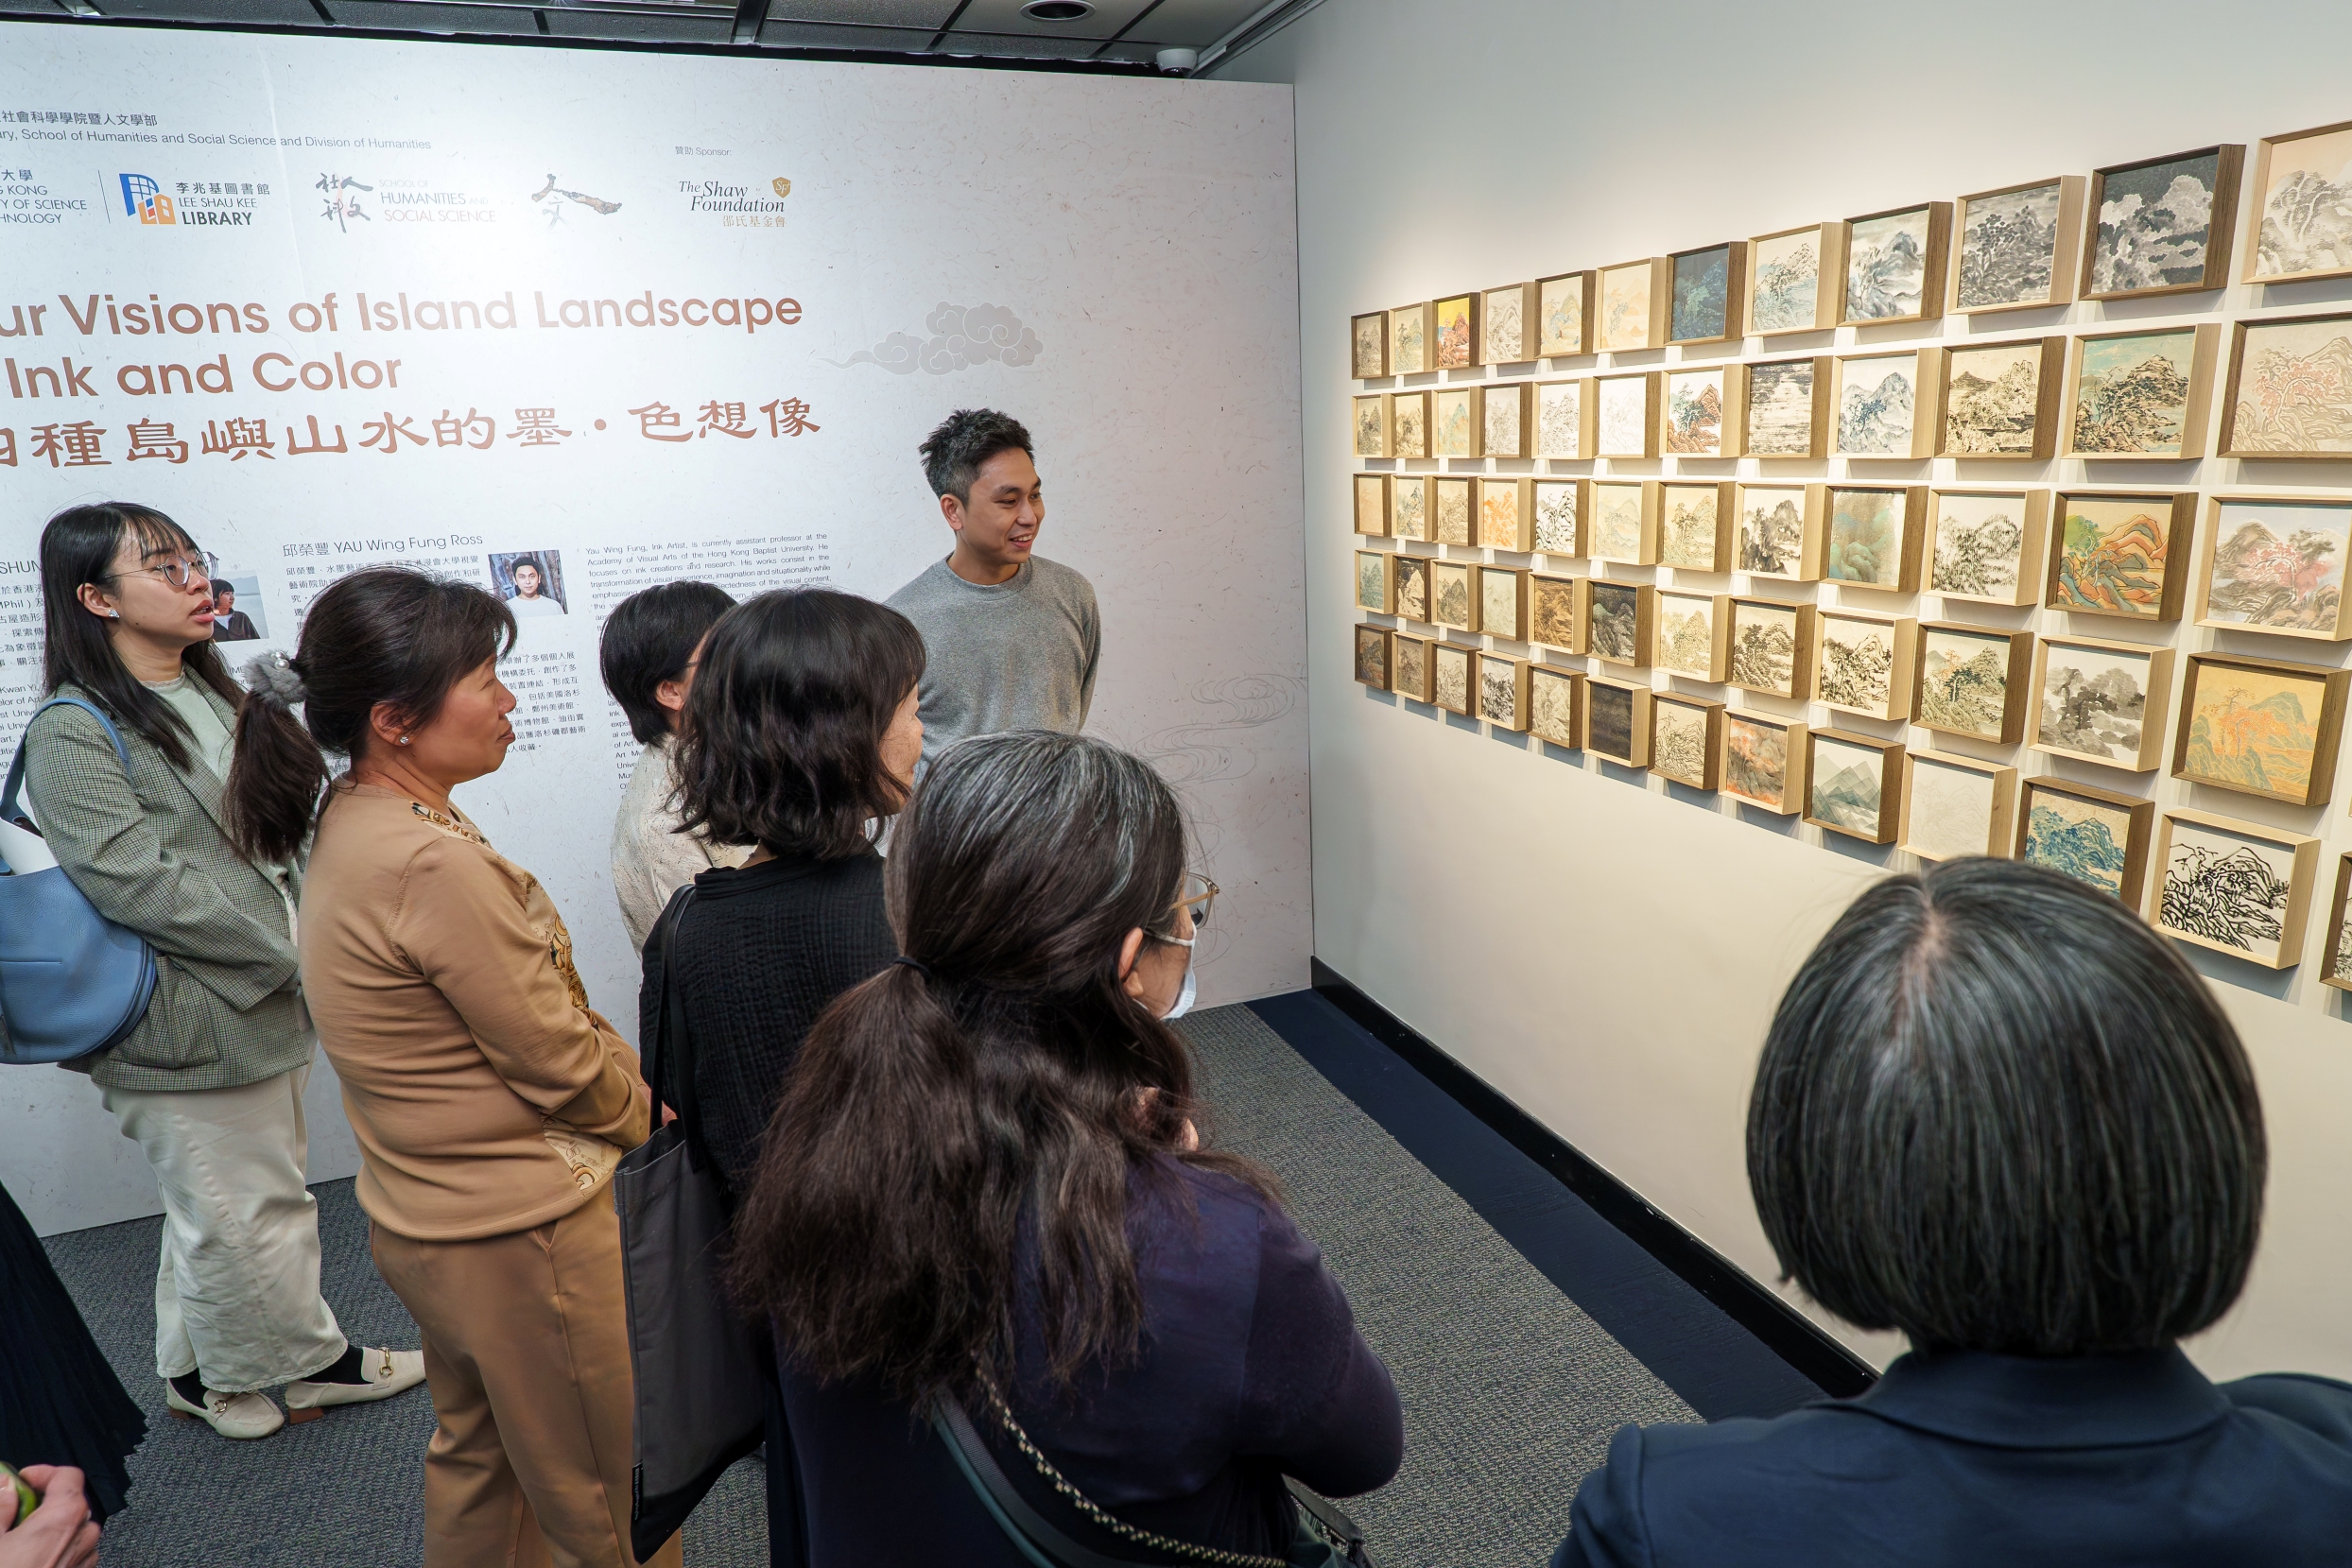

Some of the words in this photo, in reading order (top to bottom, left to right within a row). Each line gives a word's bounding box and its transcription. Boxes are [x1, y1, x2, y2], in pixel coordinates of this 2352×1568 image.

[0, 111, 158, 127] 社會科學學院暨人文學部
[21, 129, 67, 141] School
[70, 130, 83, 141] of
[86, 130, 159, 143] Humanities
[161, 133, 184, 144] and
[187, 133, 226, 145] Social
[229, 133, 277, 146] Science
[280, 136, 303, 146] and
[305, 136, 351, 147] Division
[354, 138, 366, 148] of
[369, 138, 432, 150] Humanities
[695, 146, 733, 158] Sponsor:
[1, 169, 34, 181] 大學
[7, 184, 48, 196] KONG
[176, 181, 270, 196] 李兆基圖書館
[379, 179, 415, 188] SCHOOL
[417, 180, 429, 188] OF
[679, 181, 701, 193] The
[702, 181, 749, 197] Shaw
[13, 198, 30, 209] OF
[34, 198, 88, 211] SCIENCE
[179, 197, 198, 208] LEE
[200, 198, 233, 209] SHAU
[236, 198, 258, 209] KEE
[380, 192, 467, 205] HUMANITIES
[469, 197, 490, 206] AND
[690, 196, 786, 213] Foundation
[182, 211, 252, 226] LIBRARY
[384, 209, 436, 222] SOCIAL
[439, 210, 497, 223] SCIENCE
[722, 215, 787, 228] 邵氏基金會
[59, 293, 271, 336] Visions
[288, 291, 339, 335] of
[356, 291, 517, 333] Island
[535, 290, 804, 336] Landscape
[6, 355, 99, 400] Ink
[116, 353, 234, 398] and
[251, 350, 403, 393] Color
[283, 543, 331, 558] 邱榮豐
[334, 540, 363, 554] YAU
[365, 538, 406, 553] Wing
[409, 535, 447, 550] Fung
[450, 533, 483, 546] Ross
[603, 546, 623, 555] Wing
[667, 542, 687, 550] Artist,
[701, 539, 732, 547] currently
[736, 536, 767, 545] assistant
[770, 534, 802, 543] professor
[587, 558, 623, 566] Academy
[663, 553, 678, 561] Arts
[707, 550, 727, 559] Hong
[731, 548, 750, 557] Kong
[752, 546, 778, 556] Baptist
[588, 569, 618, 577] focuses
[649, 564, 683, 573] creations
[780, 556, 805, 564] consist
[590, 578, 644, 589] transformation
[716, 569, 756, 579] imagination
[756, 568, 770, 577] and
[771, 565, 812, 576] situationality
[783, 577, 802, 585] visual
[0, 685, 26, 694] Kwan
[16, 697, 26, 705] of
